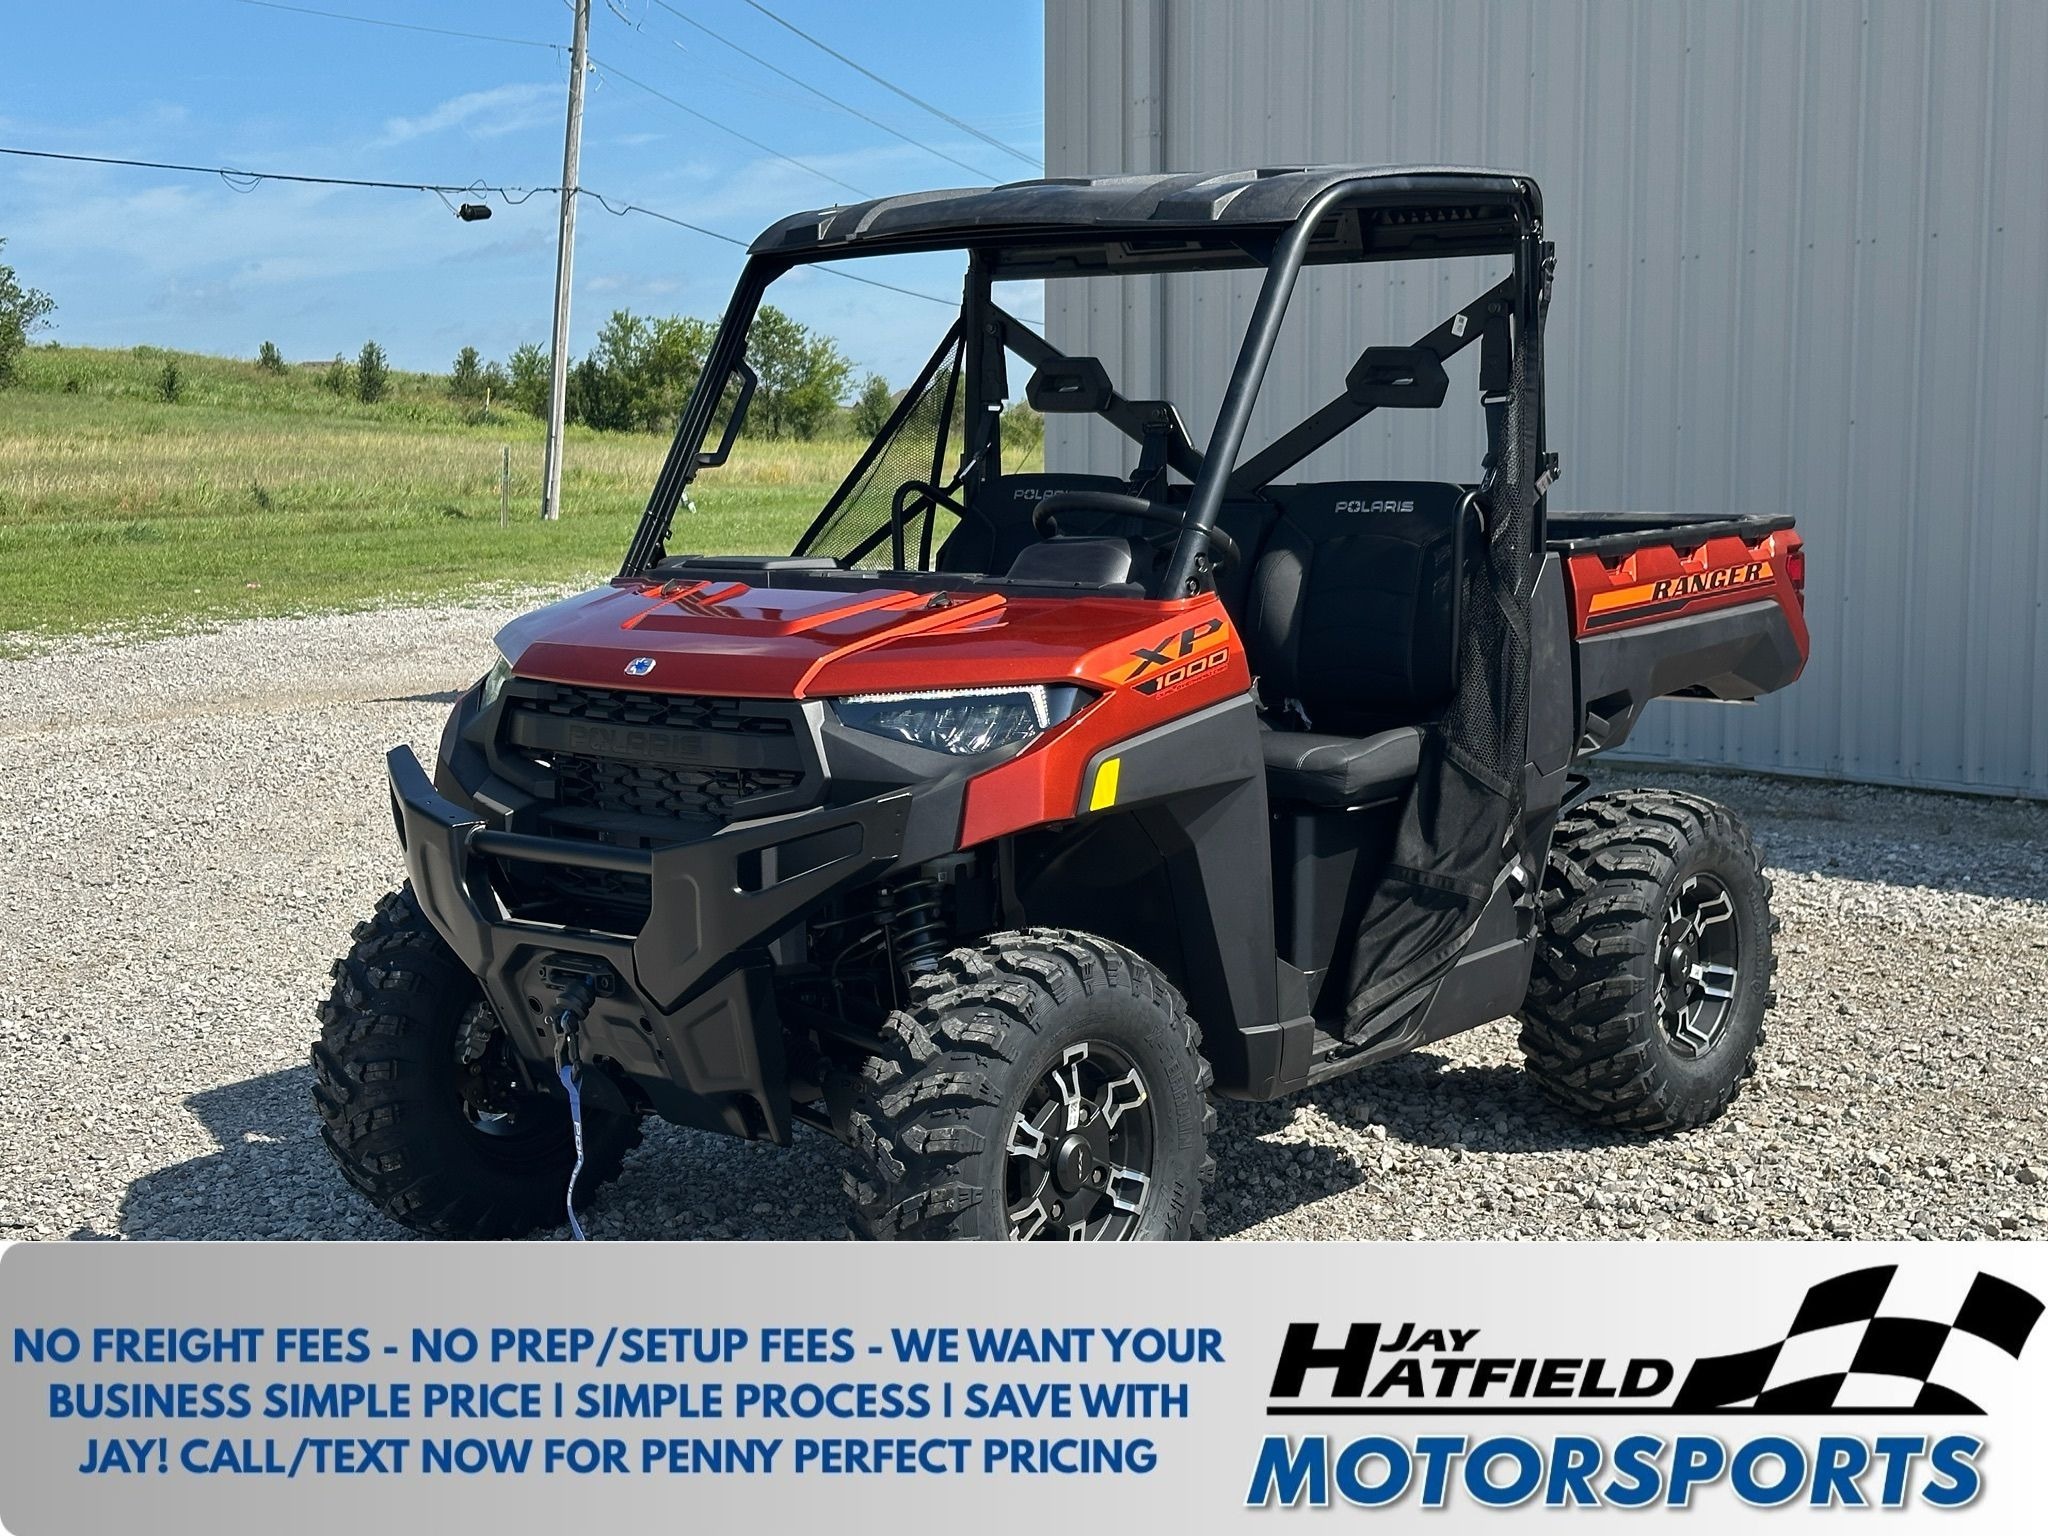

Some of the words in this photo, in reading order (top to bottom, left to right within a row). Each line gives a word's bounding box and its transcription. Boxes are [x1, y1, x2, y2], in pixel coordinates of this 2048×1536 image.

[1335, 501, 1414, 513] POLARIS
[1652, 562, 1763, 601] RANGER
[1124, 618, 1223, 682] XP
[1155, 648, 1229, 692] 1000
[569, 725, 706, 758] POLARIS
